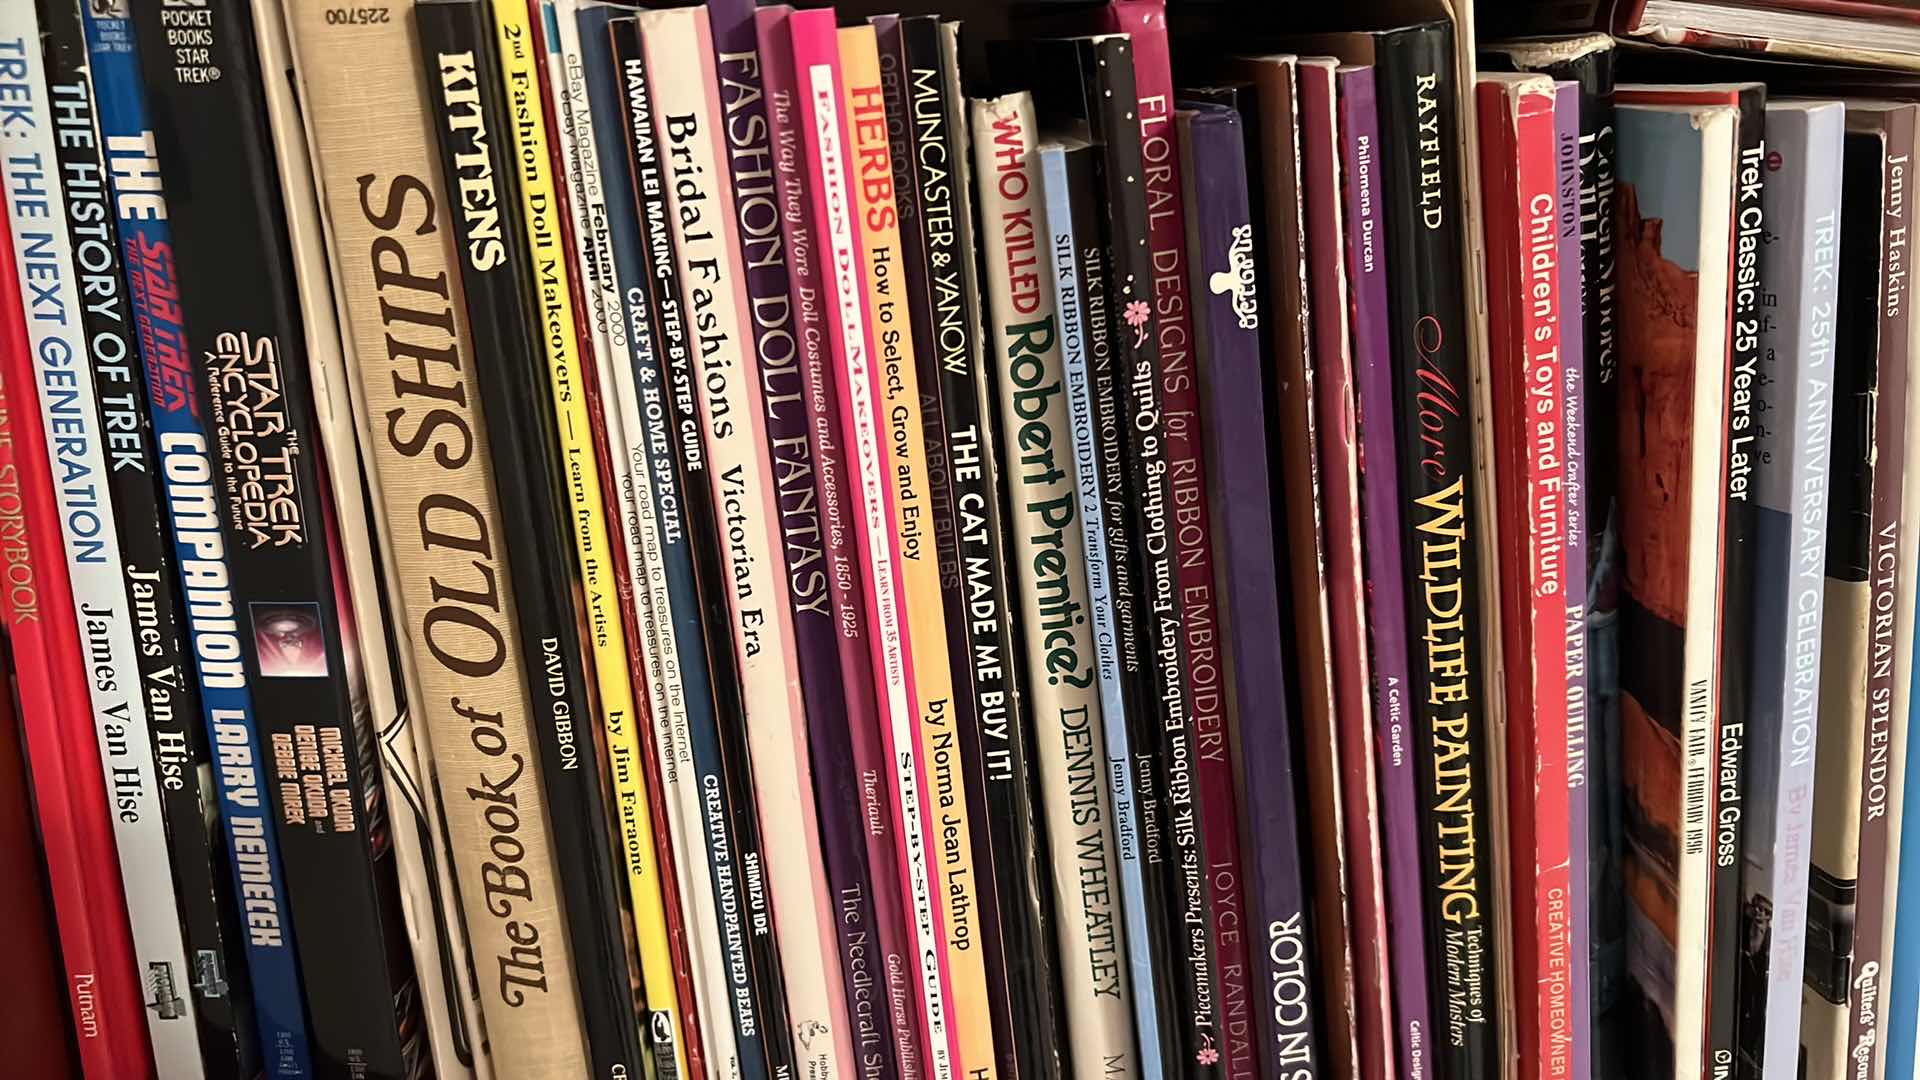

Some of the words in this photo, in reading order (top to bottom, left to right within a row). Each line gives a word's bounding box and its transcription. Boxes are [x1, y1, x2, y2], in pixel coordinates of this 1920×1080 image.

[161, 10, 212, 27] POCKET
[168, 29, 213, 46] BOOKS
[176, 48, 210, 64] STAR
[327, 7, 390, 24] 225700
[0, 38, 36, 139] TREK:
[52, 81, 94, 156] THE
[511, 71, 539, 182] Fashion
[9, 153, 49, 218] THE
[438, 50, 507, 272] KITTENS
[666, 112, 714, 244] Bridal
[719, 51, 783, 270] FASHION
[851, 85, 896, 233] HERBS
[992, 111, 1029, 200] WHO
[1138, 95, 1176, 232] FLORAL
[1357, 135, 1372, 217] Philomena
[1416, 72, 1442, 229] RAYFIELD
[1560, 133, 1578, 239] JOHNSTON
[1739, 140, 1766, 202] Trek
[1886, 154, 1908, 219] Jenny
[530, 193, 553, 248] Doll
[567, 53, 584, 107] eBay
[577, 110, 600, 197] Magazine
[591, 203, 614, 294] February
[607, 301, 626, 346] 2000
[911, 69, 954, 247] MUNCASTER
[935, 272, 968, 376] YANOW
[22, 232, 66, 325] NEXT
[65, 160, 122, 323] HISTORY
[624, 59, 656, 163] HAWAIIAN
[641, 168, 660, 196] LEI
[681, 420, 703, 472] GUIDE
[872, 246, 891, 296] How
[1002, 208, 1041, 315] KILLED
[1056, 234, 1073, 280] SILK
[1360, 219, 1374, 272] Durcan
[1736, 206, 1762, 313] Classic:
[1813, 211, 1836, 292] TREK:
[1886, 226, 1907, 317] Haskins
[357, 172, 473, 470] SHIPS
[539, 259, 573, 402] Makeovers
[627, 287, 654, 363] CRAFT
[688, 257, 733, 440] Fashions
[818, 91, 844, 235] FASHION
[851, 346, 880, 529] MAKEOVERS
[1061, 286, 1081, 364] RIBBON
[1153, 248, 1190, 393] DESIGNS
[1735, 319, 1759, 352] 25
[1809, 302, 1832, 368] 25th
[92, 331, 131, 386] OF
[240, 331, 285, 438] STAR
[753, 294, 801, 420] DOLL
[883, 330, 906, 400] Select,
[1132, 361, 1160, 432] Quilts
[1413, 315, 1460, 478] More
[1531, 346, 1558, 414] Toys
[1732, 356, 1757, 430] Years
[102, 393, 145, 473] TREK
[105, 129, 168, 221] THE
[160, 432, 246, 689] COMPANION
[644, 387, 667, 455] HOME
[892, 406, 909, 458] Grow
[1006, 313, 1066, 486] Robert
[1069, 373, 1096, 506] EMBROIDERY
[39, 337, 106, 563] GENERATION
[216, 332, 271, 549] ENCYCLOPEDIA
[568, 448, 585, 503] Learn
[951, 424, 982, 483] THE
[1536, 421, 1561, 471] and
[1729, 436, 1755, 501] Later
[1797, 381, 1829, 580] ANNIVERSARY
[261, 446, 303, 547] TREK
[655, 456, 681, 544] SPECIAL
[897, 463, 919, 500] and
[959, 493, 988, 545] CAT
[1143, 458, 1168, 555] Clothing
[1172, 458, 1206, 569] RIBBON
[578, 509, 593, 552] from
[721, 464, 755, 601] Victorian
[772, 436, 830, 617] FANTASY
[901, 503, 921, 561] Enjoy
[1538, 478, 1565, 595] Furniture
[128, 564, 163, 658] James
[418, 494, 507, 678] OLD
[588, 589, 608, 648] Artists
[965, 557, 997, 635] MADE
[1027, 491, 1094, 690] Prentice?
[1153, 558, 1173, 613] From
[1413, 474, 1469, 706] WILDLIFE
[1874, 520, 1898, 680] VICTORIAN
[81, 602, 117, 692] James
[541, 637, 567, 698] DAVID
[741, 607, 765, 658] Era
[975, 645, 1002, 682] ME
[1565, 604, 1584, 680] PAPER
[147, 665, 174, 722] Van
[1157, 614, 1184, 734] Embroidery
[1184, 584, 1225, 763] EMBROIDERY
[1790, 591, 1819, 768] CELEBRATION
[102, 702, 131, 756] Van
[450, 696, 508, 757] of
[552, 700, 578, 770] GIBBON
[981, 691, 1009, 740] BUY
[1566, 685, 1585, 789] QUILLING
[1866, 687, 1891, 822] SPLENDOR
[113, 767, 142, 823] Hise
[157, 730, 188, 791] Hise
[211, 708, 260, 807] LARRY
[271, 733, 299, 780] DEBBIE
[302, 774, 328, 818] OKUDA
[319, 727, 349, 786] MICHAEL
[932, 731, 954, 808] Norma
[986, 749, 1013, 782] IT!
[1060, 704, 1101, 826] DENNIS
[1109, 756, 1125, 797] Jenny
[1169, 735, 1192, 805] Ribbon
[1720, 722, 1744, 804] Edward
[280, 782, 306, 826] MIREK
[329, 788, 355, 832] OKUDA
[466, 754, 533, 918] Book
[613, 745, 630, 783] Jim
[622, 791, 643, 876] Faraone
[863, 769, 883, 835] Theriault
[942, 814, 961, 864] Jean
[1115, 801, 1136, 861] Bradford
[1174, 807, 1196, 847] Silk
[1431, 712, 1481, 925] PAINTING
[1717, 806, 1741, 867] Gross
[230, 816, 283, 947] NEMECEK
[703, 774, 729, 862] CREATIVE
[717, 864, 747, 984] HANDPAINTED
[735, 987, 756, 1036] BEARS
[744, 852, 766, 912] SHIMIZU
[901, 752, 930, 936] STEP-BY-STEP
[926, 949, 943, 1033] GUIDE
[949, 868, 971, 951] Lathrop
[1076, 829, 1121, 999] WHEATLEY
[1181, 850, 1203, 924] Presents:
[497, 920, 549, 1008] The
[753, 912, 768, 936] IDE
[1445, 928, 1465, 991] Modern
[1548, 887, 1565, 969] CREATIVE
[74, 973, 98, 1038] Putnam
[1188, 928, 1213, 1027] Piecemakers
[1268, 911, 1308, 1027] COLOR
[1464, 925, 1484, 1005] Techniques
[1448, 990, 1467, 1047] Masters
[1549, 969, 1566, 1076] HOMEOWNER
